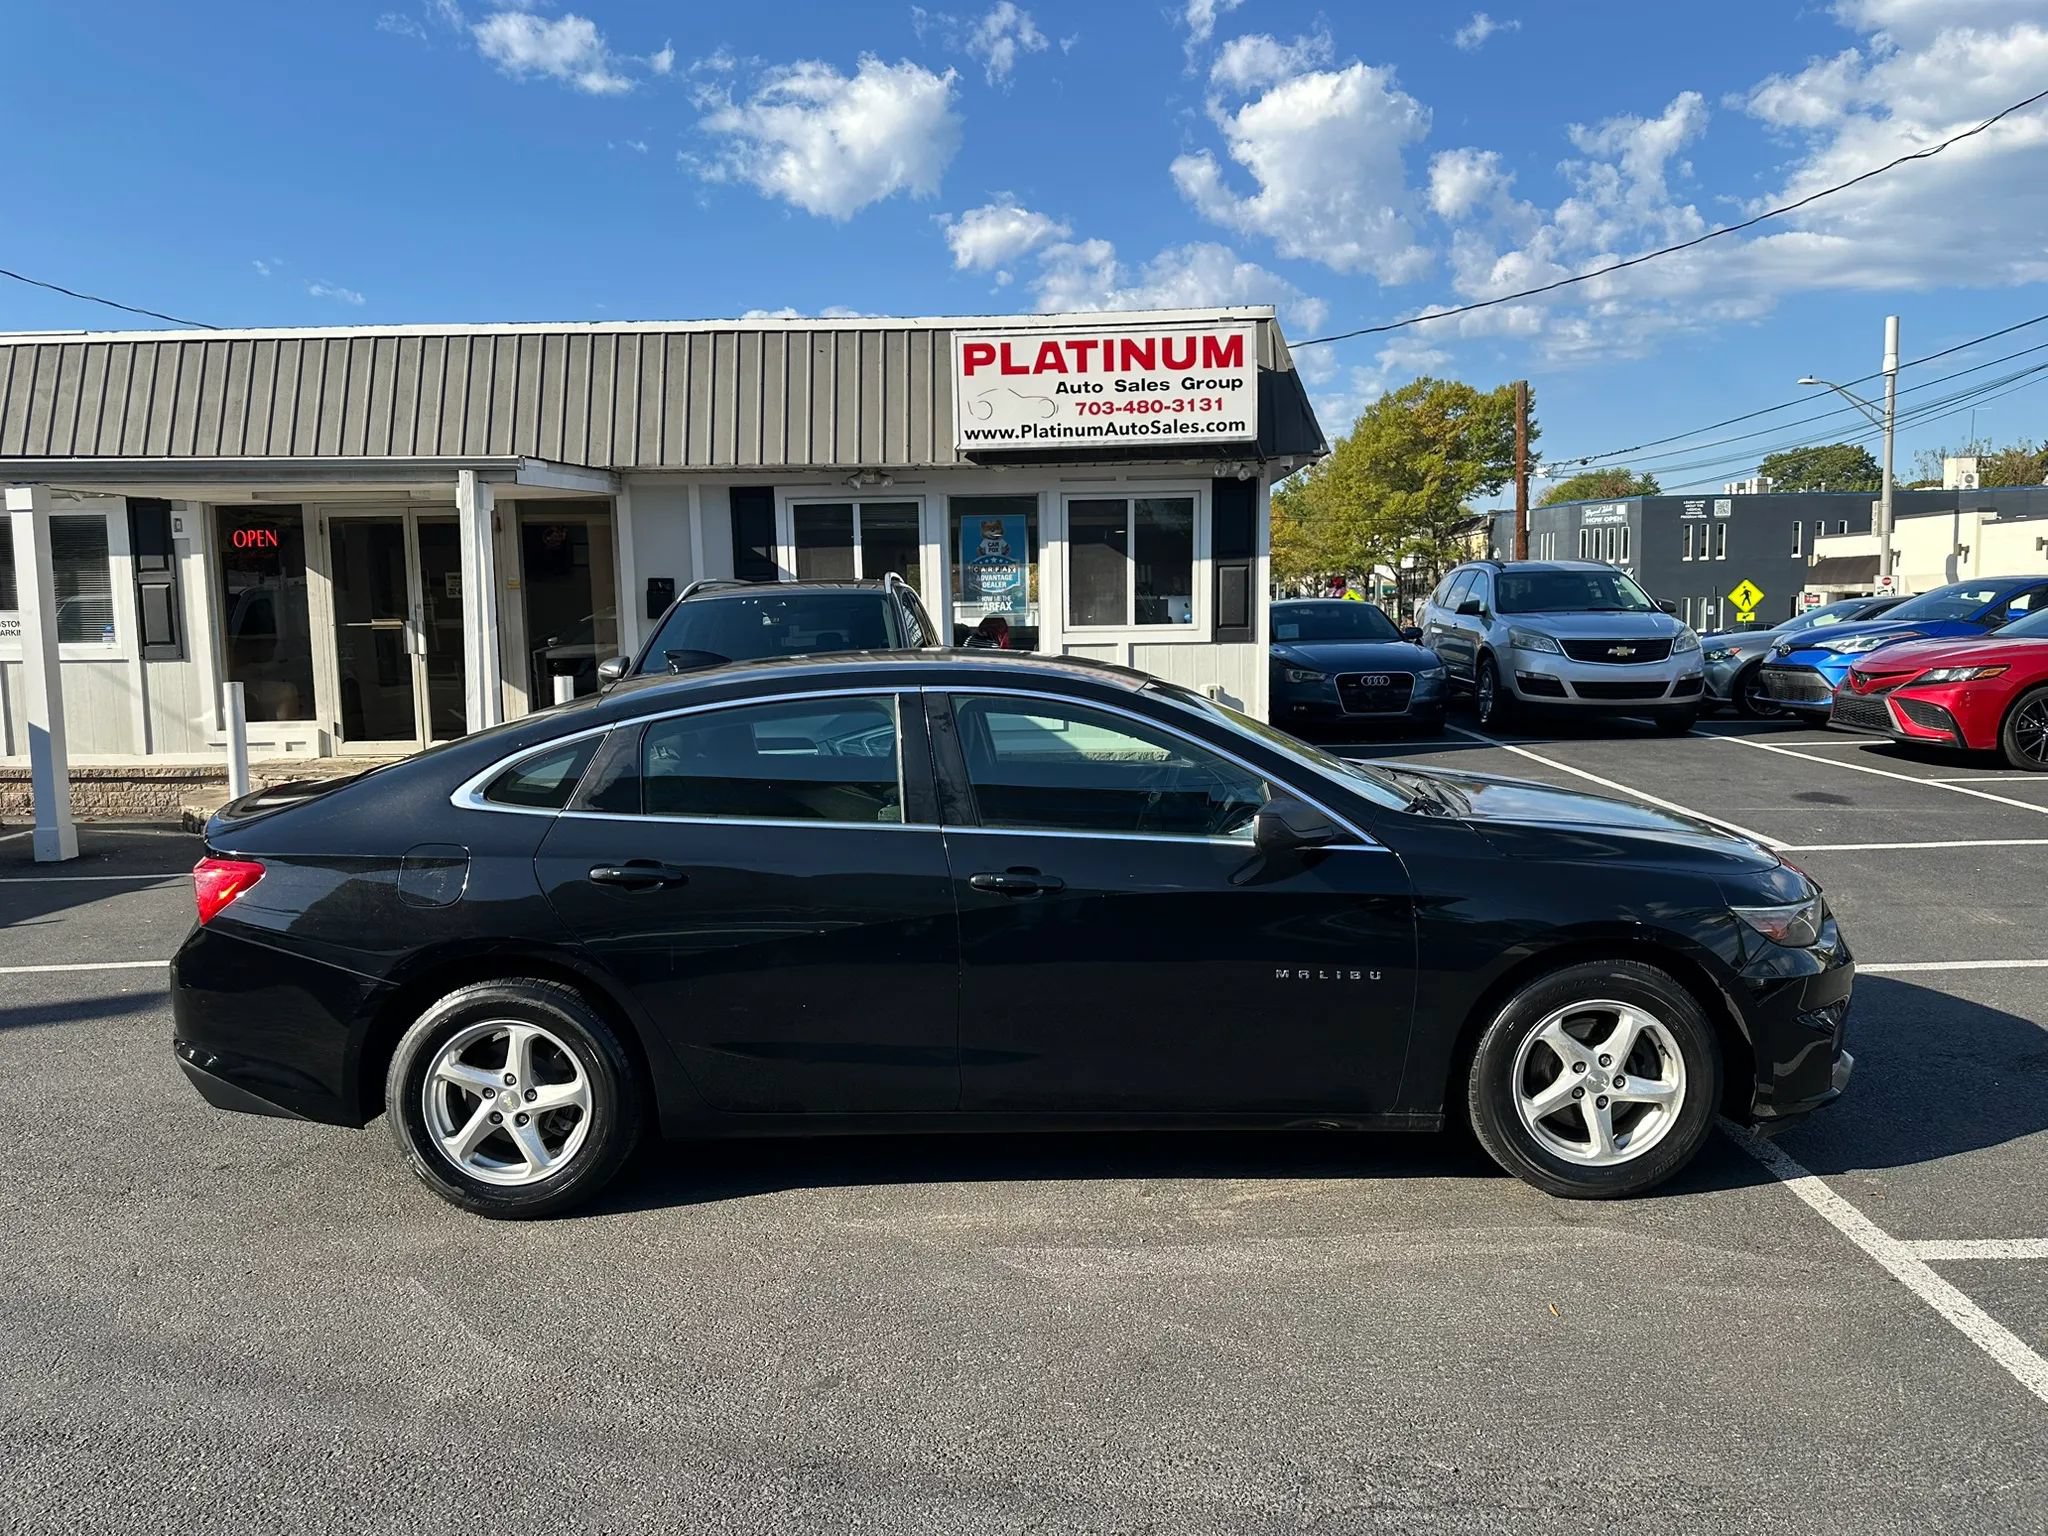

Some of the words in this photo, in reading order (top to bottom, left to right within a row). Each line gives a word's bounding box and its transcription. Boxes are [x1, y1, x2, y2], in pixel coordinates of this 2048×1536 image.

[963, 334, 1243, 376] PLATINUM
[1055, 381, 1104, 395] Auto
[1114, 378, 1170, 393] Sales
[1181, 376, 1243, 392] Group
[1075, 397, 1224, 416] 703-480-3131
[964, 419, 1246, 440] www.PlatinumAutoSales.com
[233, 529, 277, 548] OPEN
[0, 620, 21, 628] STO
[1275, 969, 1382, 980] MALIBU
